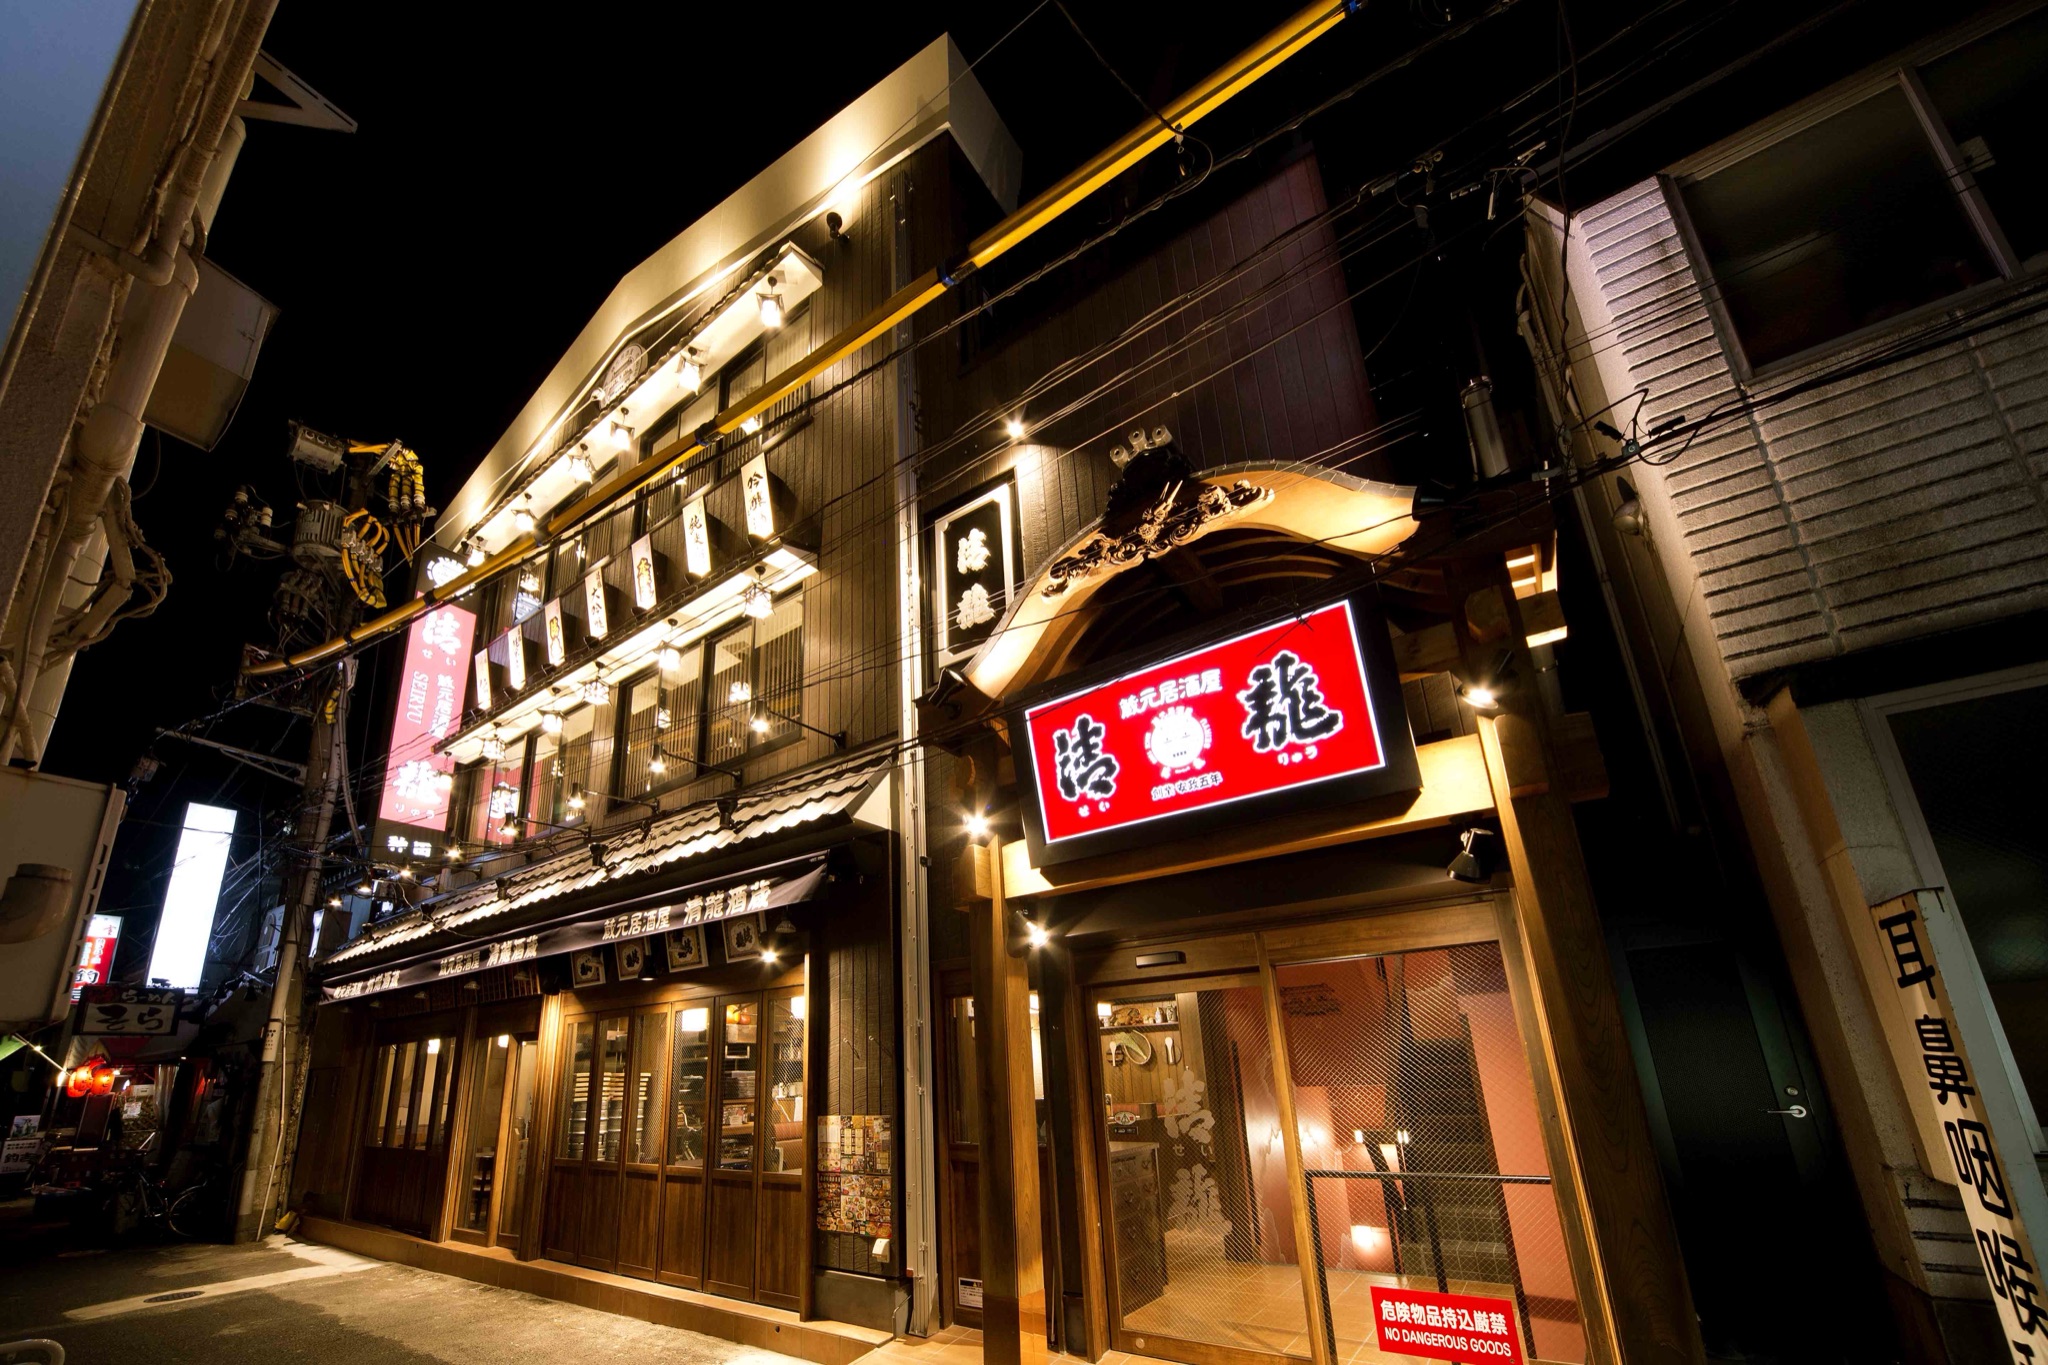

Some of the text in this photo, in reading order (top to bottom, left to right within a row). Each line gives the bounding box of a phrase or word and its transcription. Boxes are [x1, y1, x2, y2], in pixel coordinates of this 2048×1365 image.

[407, 669, 429, 726] SEIRYU
[1118, 668, 1224, 720] 蔵元居酒屋
[1054, 712, 1120, 800] 清
[1236, 649, 1344, 753] 龍
[1277, 747, 1318, 766] りゅう
[1078, 799, 1110, 818] せい
[602, 879, 772, 941] 蔵元居酒屋 清龍酒蔵
[438, 934, 539, 977] 蔵元居酒屋 清龍酒蔵
[121, 989, 176, 1004] らーめん
[96, 1004, 163, 1030] そら
[1172, 1144, 1213, 1157] せい
[1878, 909, 2048, 1365] 耳鼻咽喉
[1380, 1299, 1509, 1336] 危険物品持込厳禁
[1384, 1326, 1512, 1357] NO DANGEROUS GOODS
